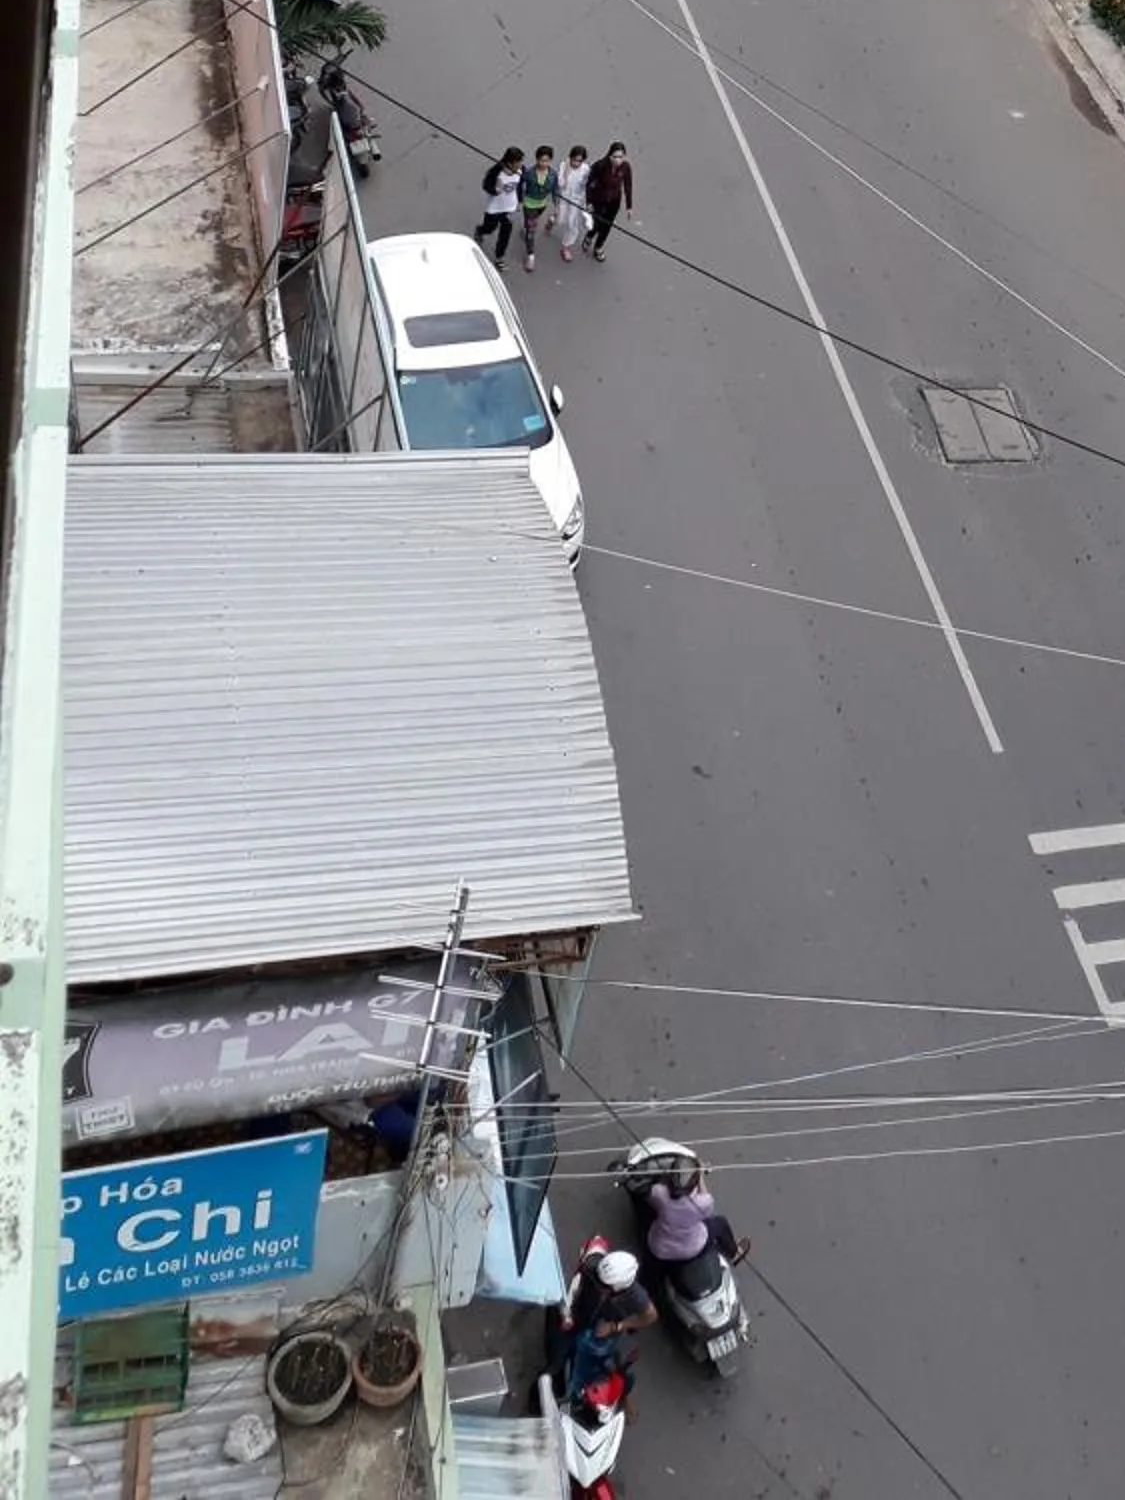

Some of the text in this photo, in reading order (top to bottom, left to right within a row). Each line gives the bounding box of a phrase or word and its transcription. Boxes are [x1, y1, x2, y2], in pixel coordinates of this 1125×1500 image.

[152, 1015, 231, 1040] GIA
[245, 997, 354, 1028] ĐÌNH
[99, 1174, 184, 1207] Hóa
[116, 1188, 273, 1253] Chi
[97, 1265, 138, 1286] Các
[145, 1251, 188, 1278] Loại
[194, 1243, 246, 1267] Nước
[253, 1234, 301, 1259] Ngọt
